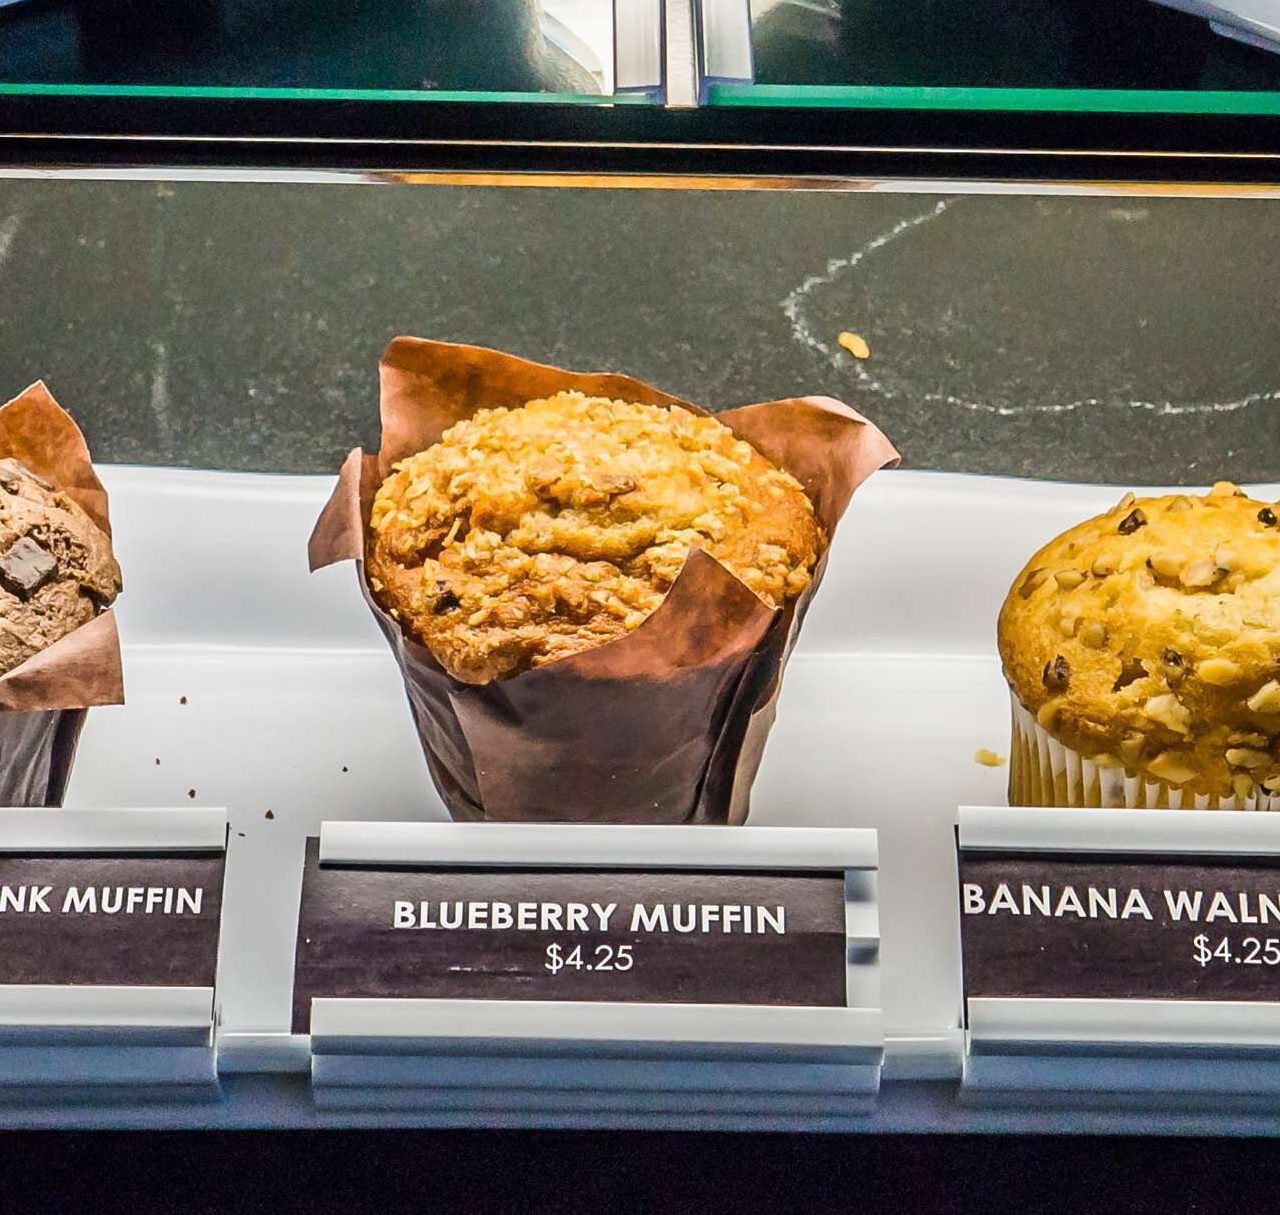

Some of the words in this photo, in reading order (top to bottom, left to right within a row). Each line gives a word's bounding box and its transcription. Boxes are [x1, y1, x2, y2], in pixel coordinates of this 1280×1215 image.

[60, 885, 204, 915] MUFFIN
[392, 899, 619, 933] BLUEBERRY
[629, 902, 786, 935] MUFFIN
[962, 882, 1155, 921] BANANA
[543, 941, 635, 976] $4.25
